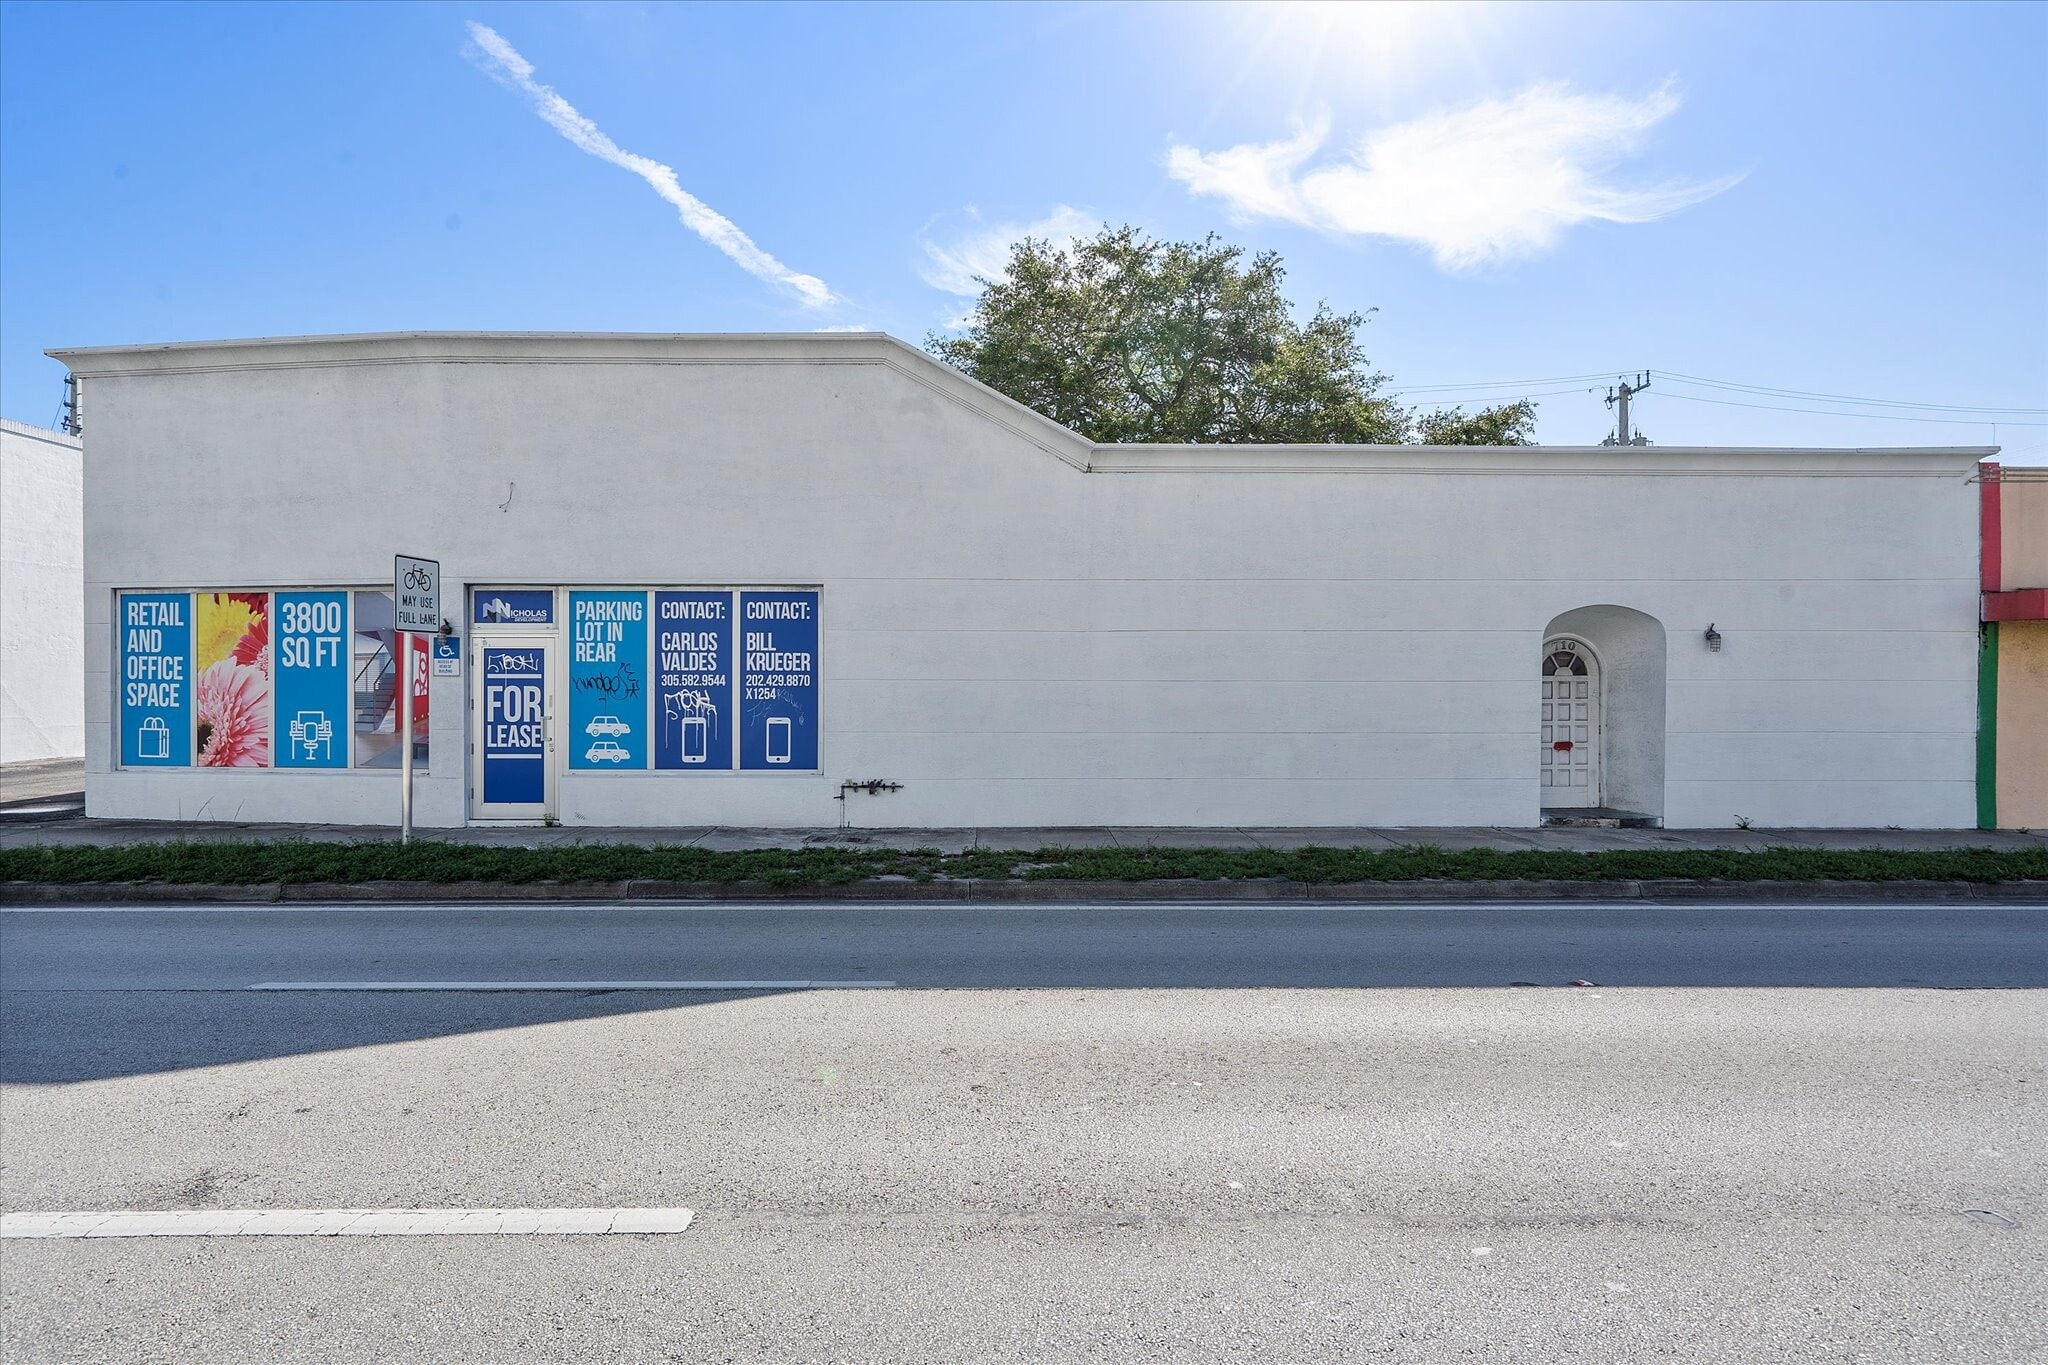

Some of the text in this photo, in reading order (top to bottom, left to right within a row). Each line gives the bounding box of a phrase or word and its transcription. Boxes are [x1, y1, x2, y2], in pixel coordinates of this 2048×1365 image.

[402, 594, 433, 609] MAY USE
[575, 601, 643, 621] PARKING
[661, 601, 726, 620] CONTACT:
[746, 601, 811, 620] CONTACT:
[127, 602, 184, 626] RETAIL
[281, 602, 342, 634] 3800
[398, 611, 437, 625] FULL LANE
[126, 629, 163, 653] AND
[575, 622, 623, 641] LOT IN
[661, 632, 718, 651] CARLOS
[746, 632, 777, 651] BILL
[281, 637, 341, 669] SQ FT
[575, 643, 616, 662] REAR
[661, 652, 717, 671] VALDES
[746, 652, 811, 671] KRUEGER
[126, 655, 184, 680] OFFICE
[661, 674, 726, 687] 305.582.9544
[745, 674, 810, 687] 202.429.8870
[126, 682, 180, 707] SPACE
[745, 687, 777, 700] X1254
[487, 685, 542, 722] FOR
[487, 724, 542, 748] LEASE
